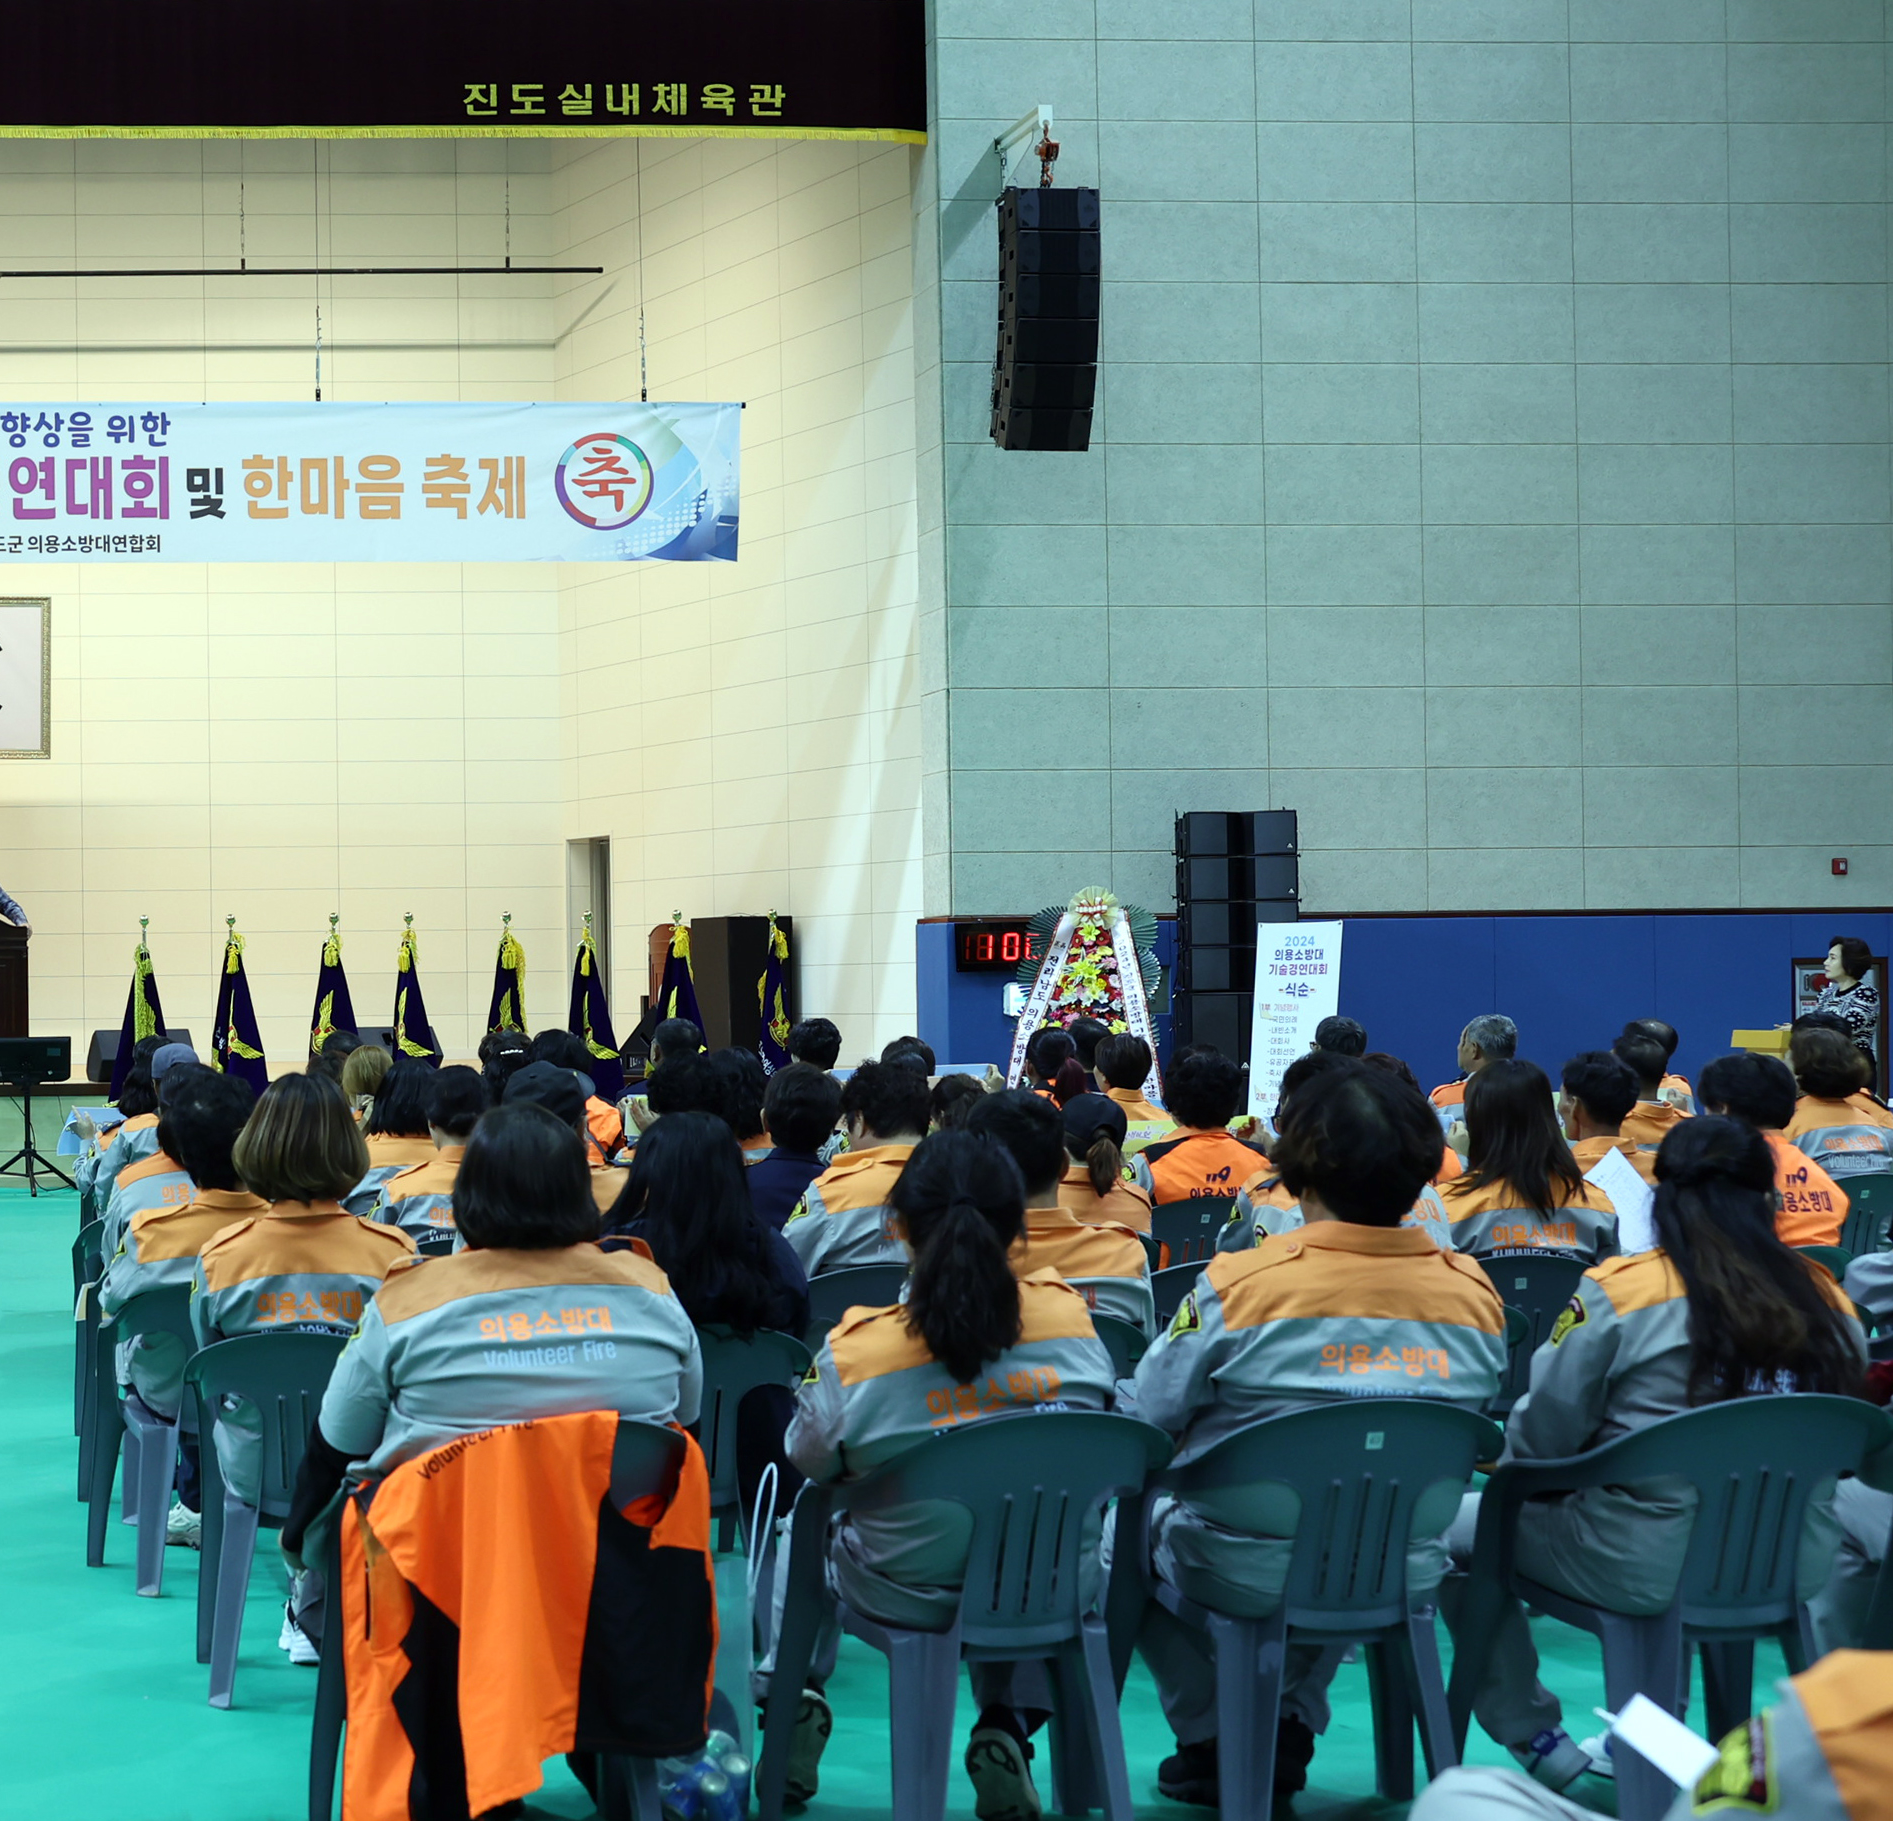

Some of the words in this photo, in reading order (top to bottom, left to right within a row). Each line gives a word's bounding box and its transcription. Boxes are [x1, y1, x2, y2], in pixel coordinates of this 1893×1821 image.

[463, 83, 786, 116] 진도실내체육관
[0, 411, 95, 448] 향상을
[106, 411, 172, 446] 위한
[186, 467, 227, 520] 및
[241, 454, 404, 520] 한마음
[421, 453, 526, 520] 축제
[571, 446, 637, 512] 축
[27, 534, 162, 553] 의용소방대연합회
[1274, 949, 1324, 961] 의용소방대
[1284, 936, 1315, 947] 2024
[1033, 955, 1059, 1001] 전라남도
[1268, 964, 1328, 976] 기술경연대회
[1491, 1221, 1577, 1250] 의용소방대
[256, 1291, 362, 1323] 의용소방대
[479, 1306, 614, 1343] 의용소방대
[483, 1345, 576, 1368] Volunteer
[582, 1340, 618, 1362] Fire
[1319, 1343, 1451, 1379] 의용소방대
